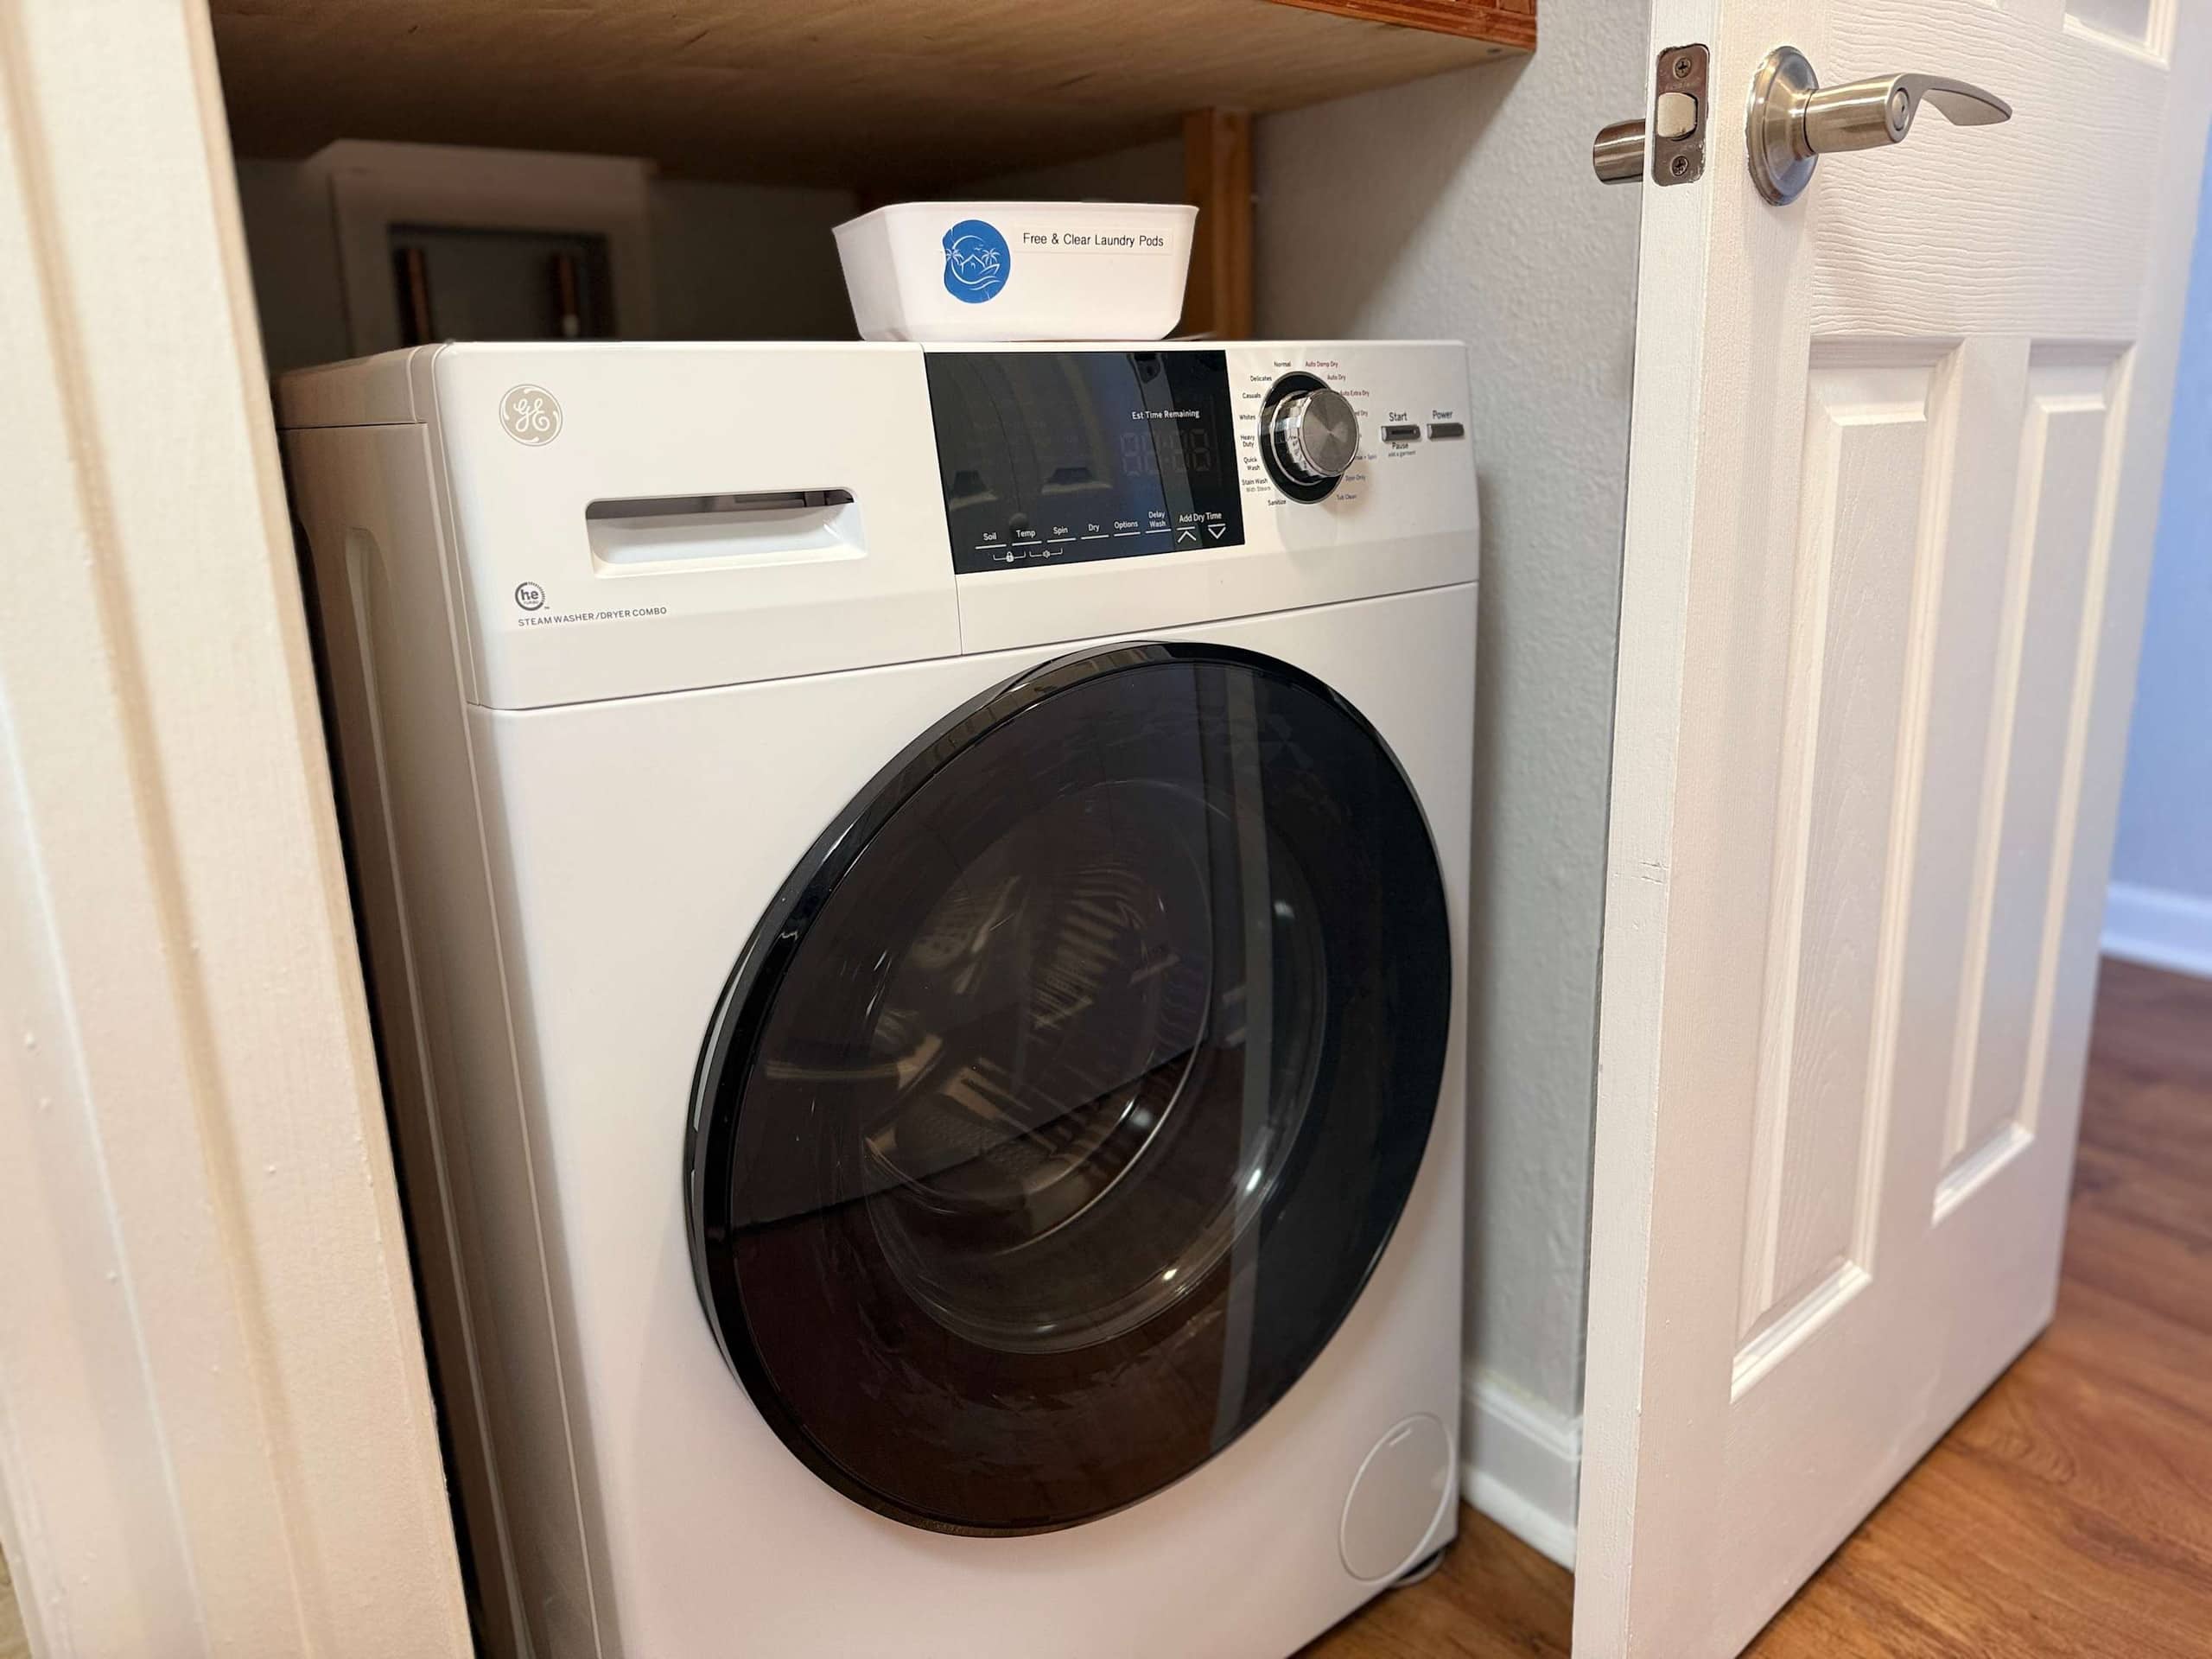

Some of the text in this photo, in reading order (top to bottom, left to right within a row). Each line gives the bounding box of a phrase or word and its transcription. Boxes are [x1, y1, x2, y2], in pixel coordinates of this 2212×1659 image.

[1023, 232, 1164, 248] Free & Clear Laundry Pods
[1132, 410, 1200, 420] Est Time Remaining
[1389, 411, 1408, 422] Start
[1432, 410, 1453, 419] Power
[1148, 511, 1166, 520] Delay
[1179, 512, 1223, 524] Add Dry Time
[1088, 523, 1100, 533] Dry
[1114, 520, 1139, 531] Options
[1149, 519, 1166, 528] Wash
[982, 531, 997, 541] Soil
[1016, 529, 1036, 539] Temp
[1052, 525, 1069, 537] Spin
[520, 588, 539, 601] he
[518, 607, 667, 627] STEAM WASHER/DRYER COMBO
